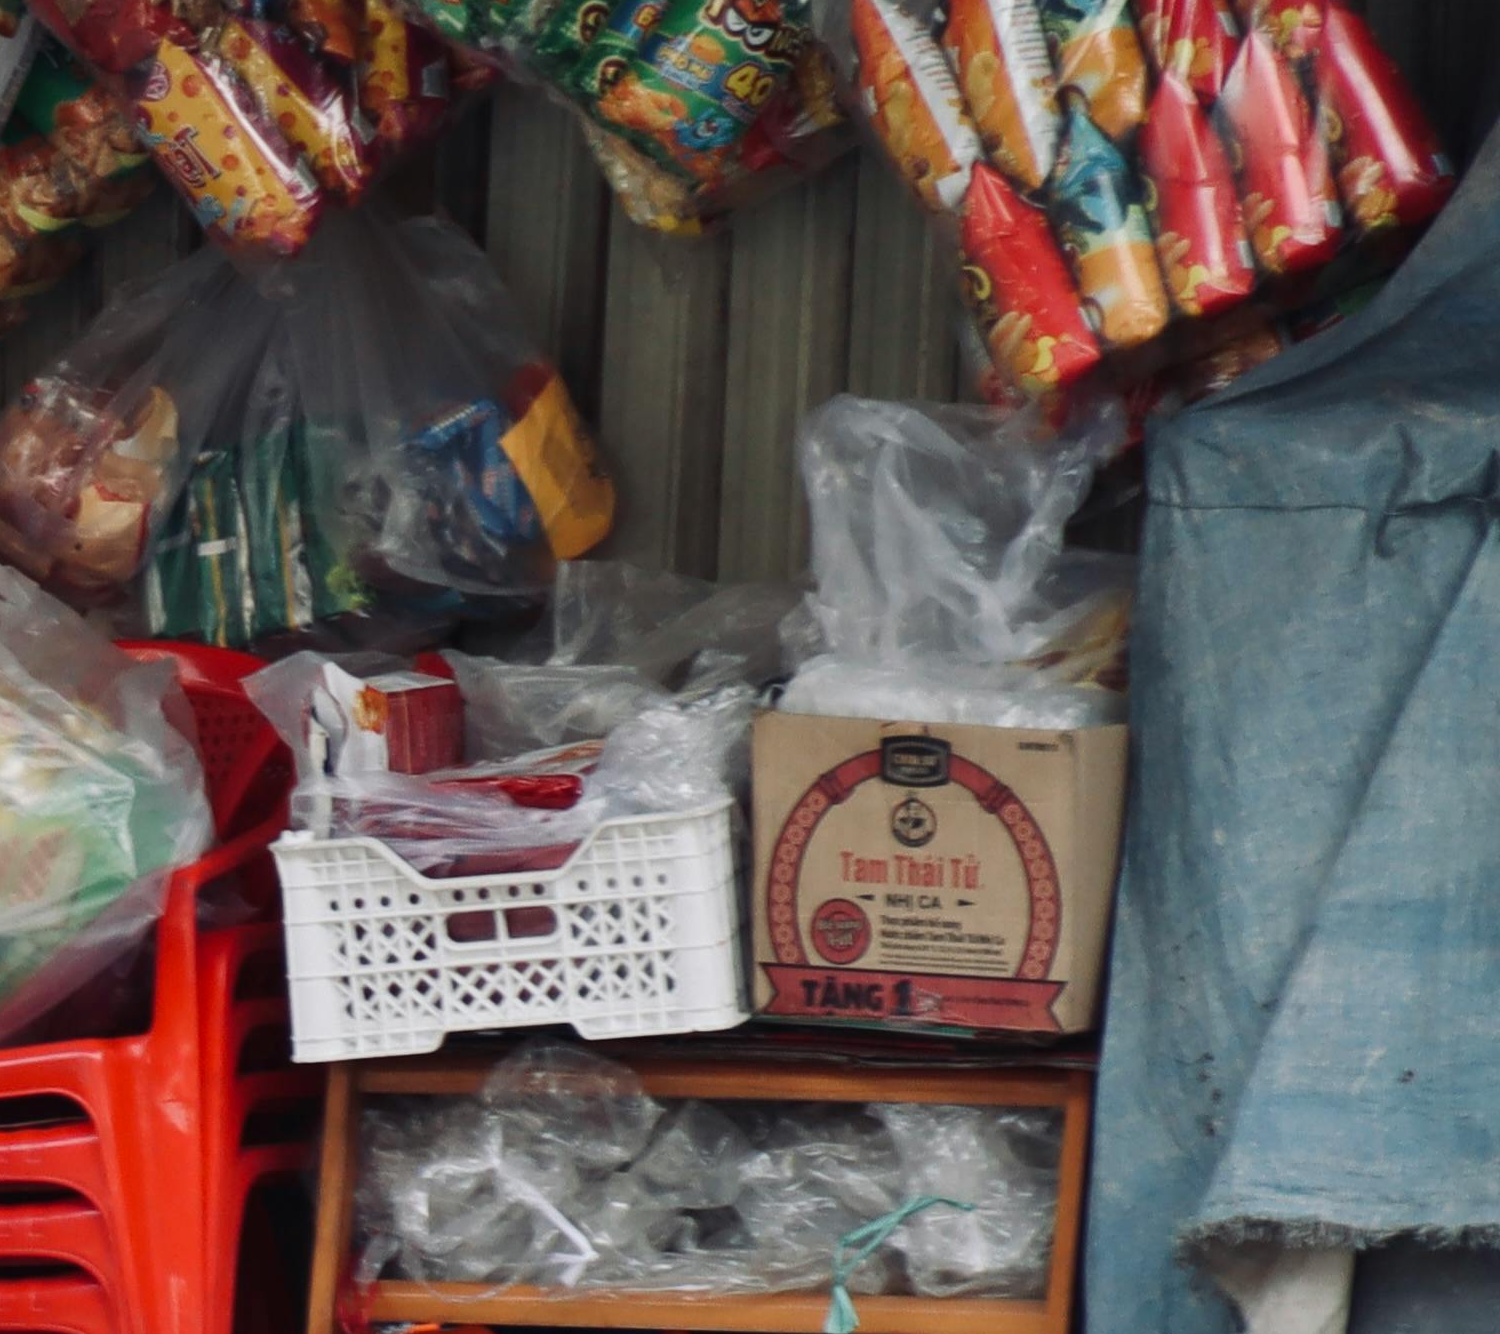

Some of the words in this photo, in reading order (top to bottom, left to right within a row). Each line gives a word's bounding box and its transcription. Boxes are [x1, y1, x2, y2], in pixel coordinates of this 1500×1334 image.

[840, 851, 888, 884] Tam
[918, 895, 943, 909] CA
[892, 978, 913, 1016] 1
